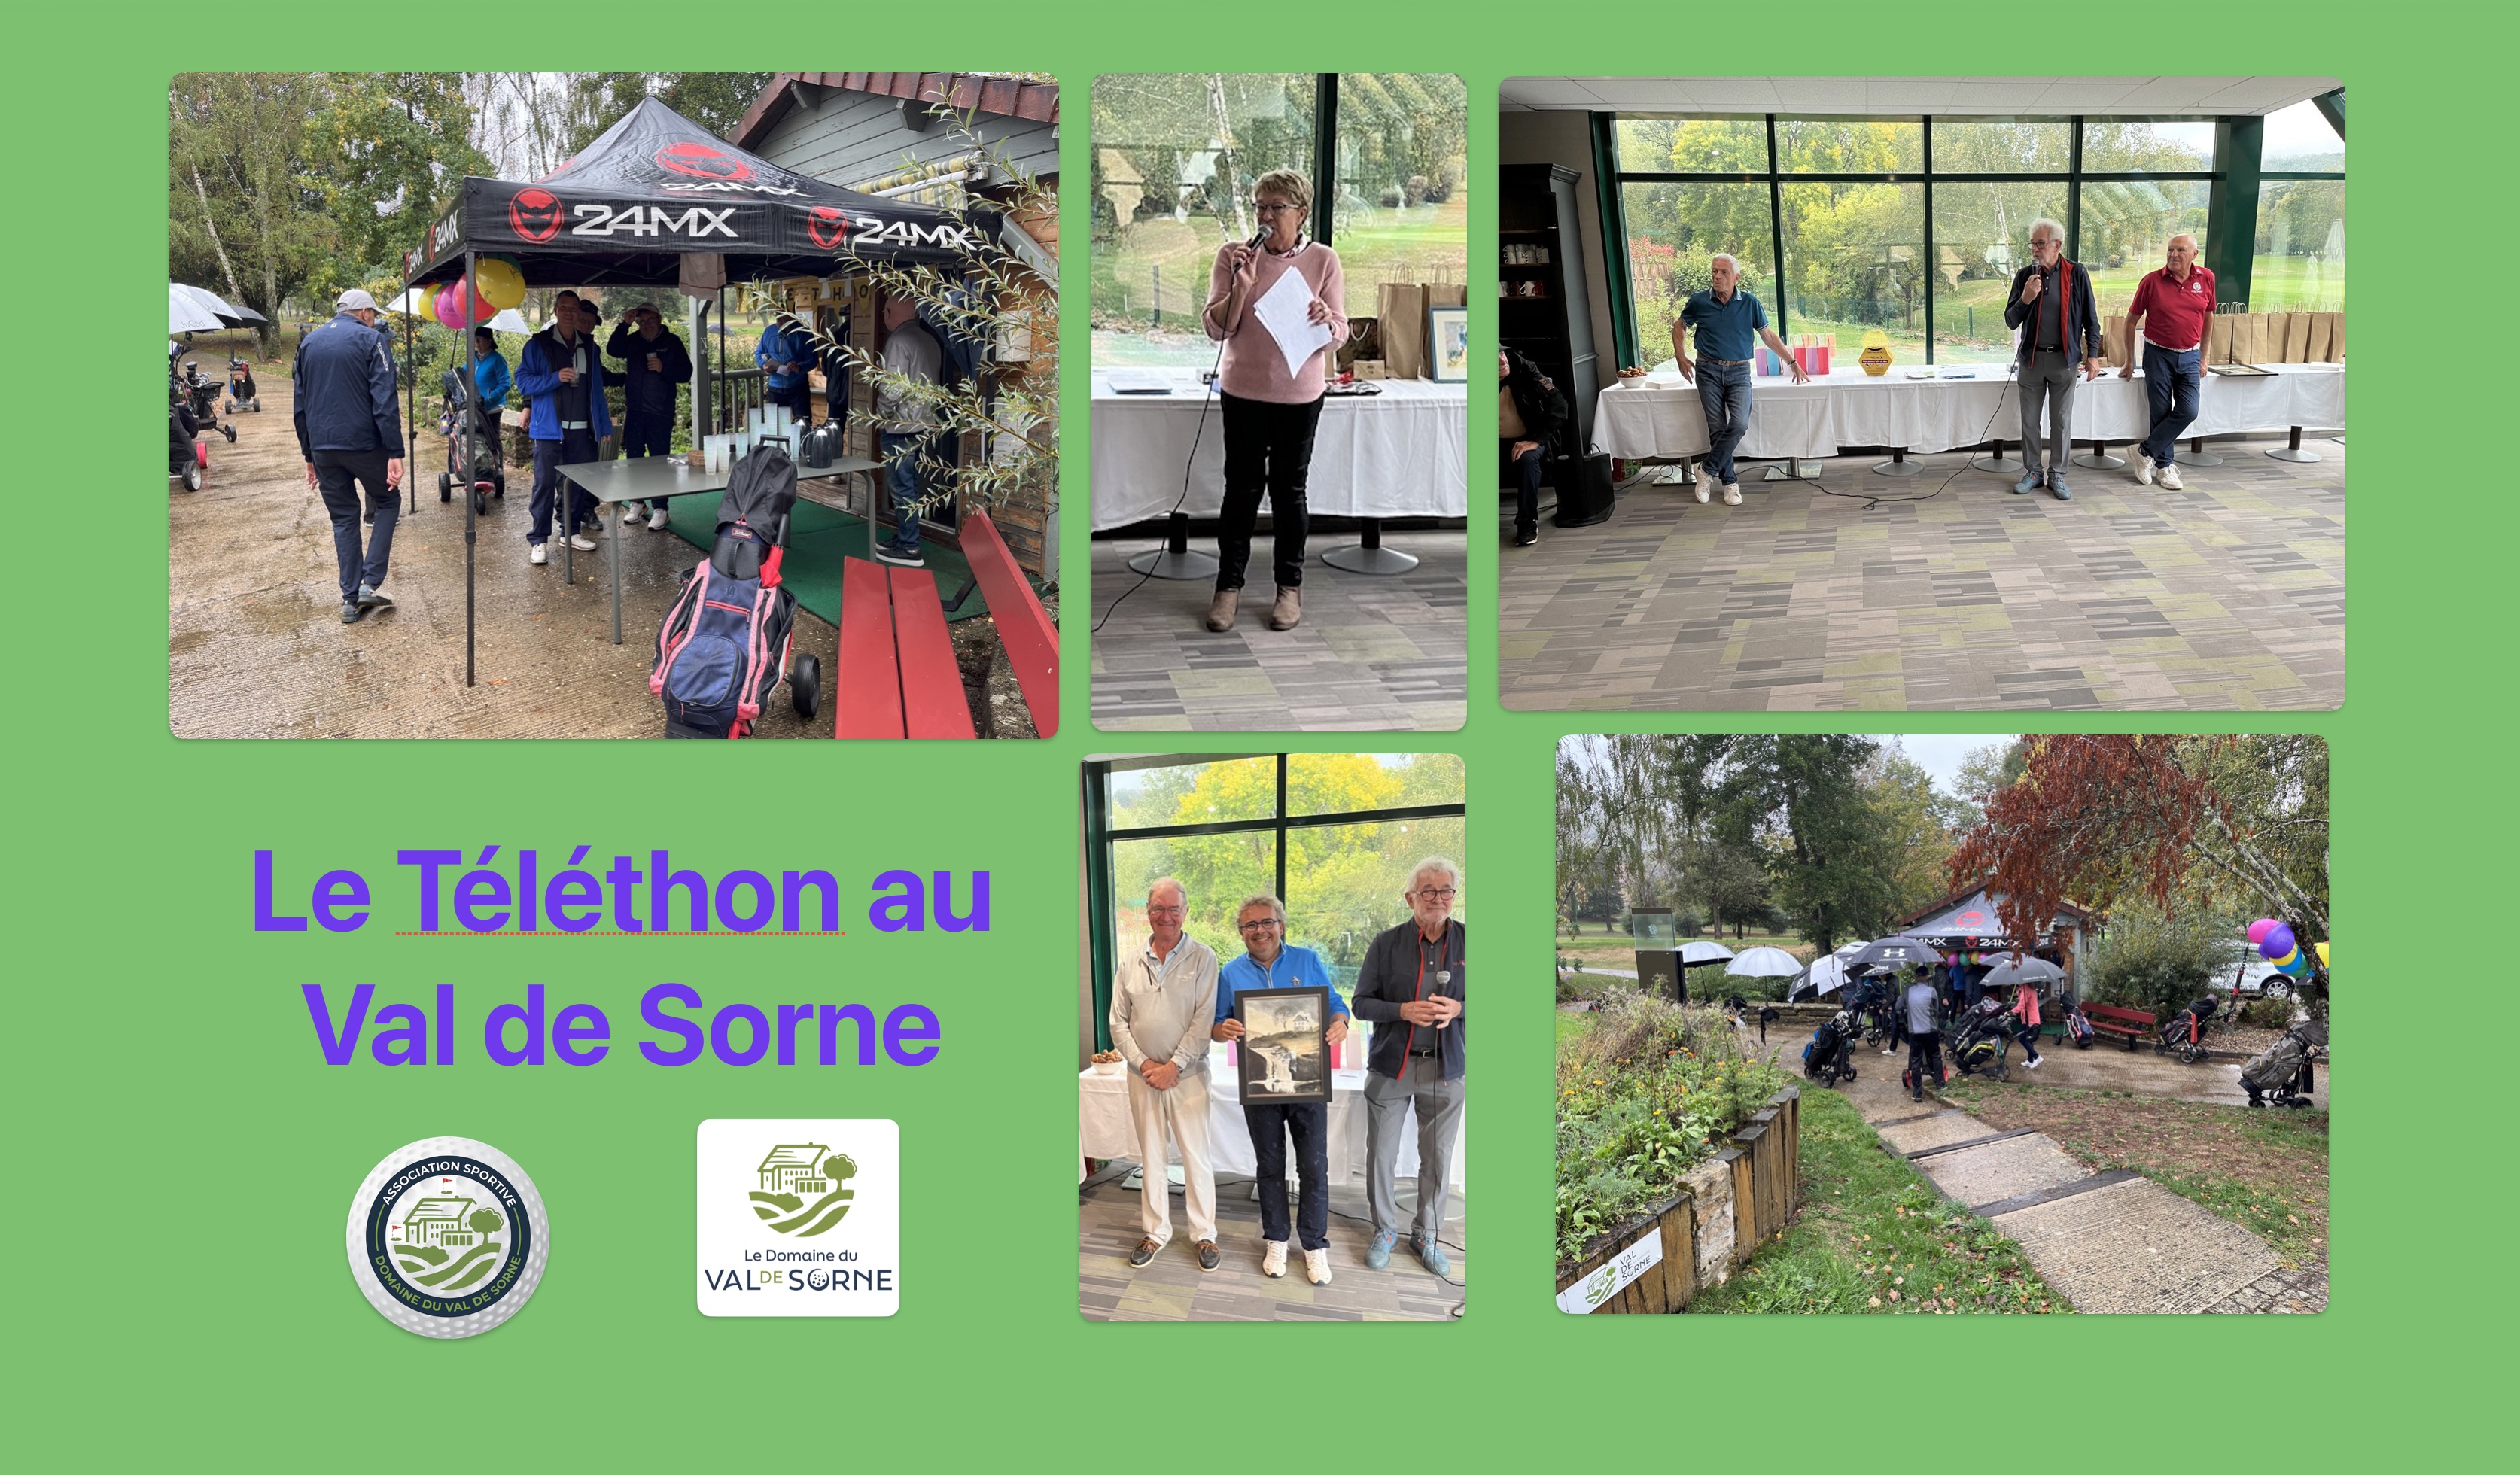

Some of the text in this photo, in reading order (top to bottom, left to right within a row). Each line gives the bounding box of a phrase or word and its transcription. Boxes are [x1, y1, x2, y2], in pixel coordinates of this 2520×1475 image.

[435, 209, 458, 253] 24MX
[572, 205, 739, 238] 24MX
[854, 217, 978, 251] 24MX
[181, 320, 205, 329] JuCad
[1620, 1251, 1636, 1265] VAL
[1621, 1261, 1633, 1274] DE
[1622, 1255, 1651, 1282] SORNE
